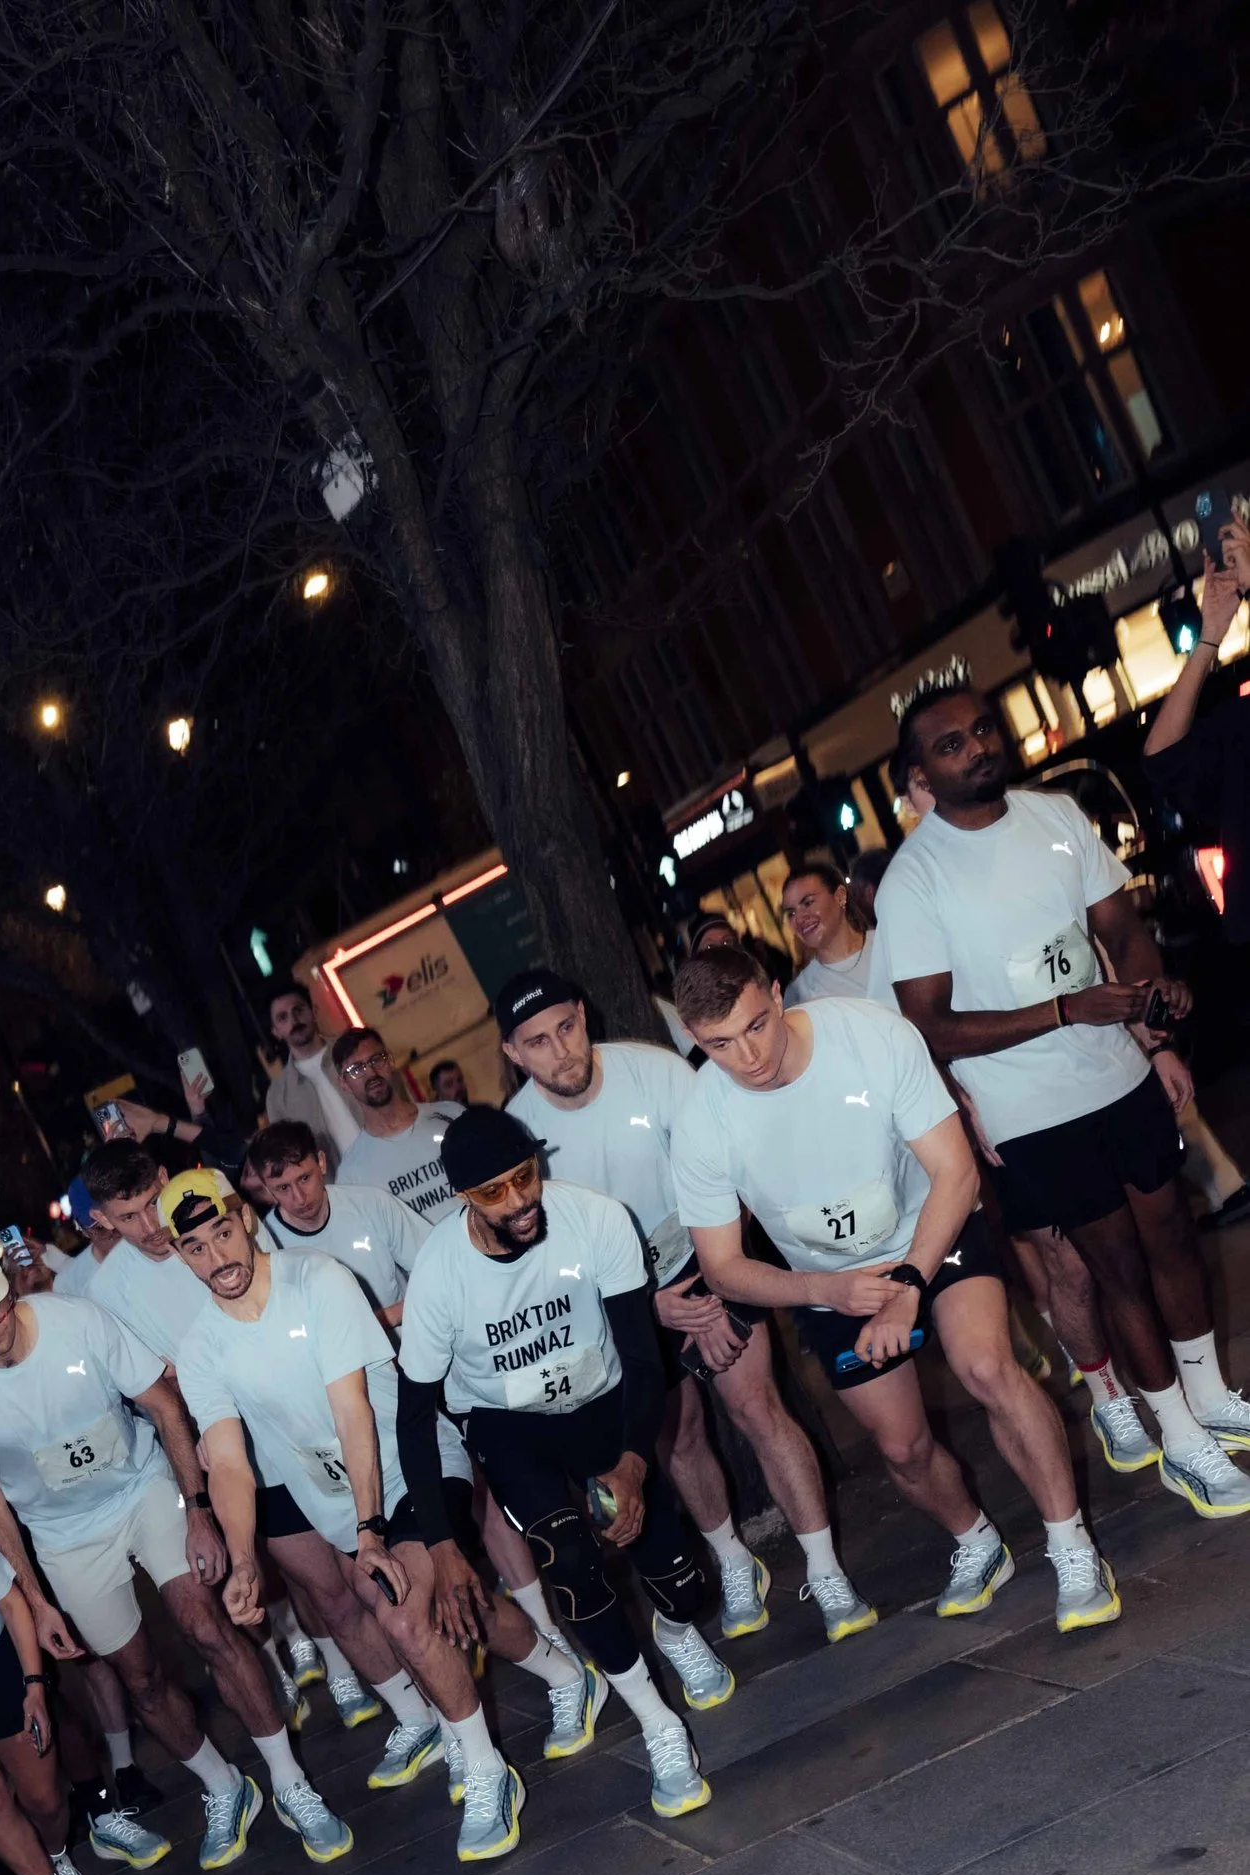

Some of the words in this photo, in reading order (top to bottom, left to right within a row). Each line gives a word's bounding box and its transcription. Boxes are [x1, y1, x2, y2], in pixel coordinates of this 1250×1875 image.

[406, 952, 449, 993] elis
[1044, 949, 1071, 984] 76
[827, 1209, 856, 1240] 27
[485, 1294, 572, 1346] BRIXTON
[493, 1324, 574, 1372] RUNNAZ
[544, 1375, 572, 1403] 54
[69, 1445, 95, 1469] 63
